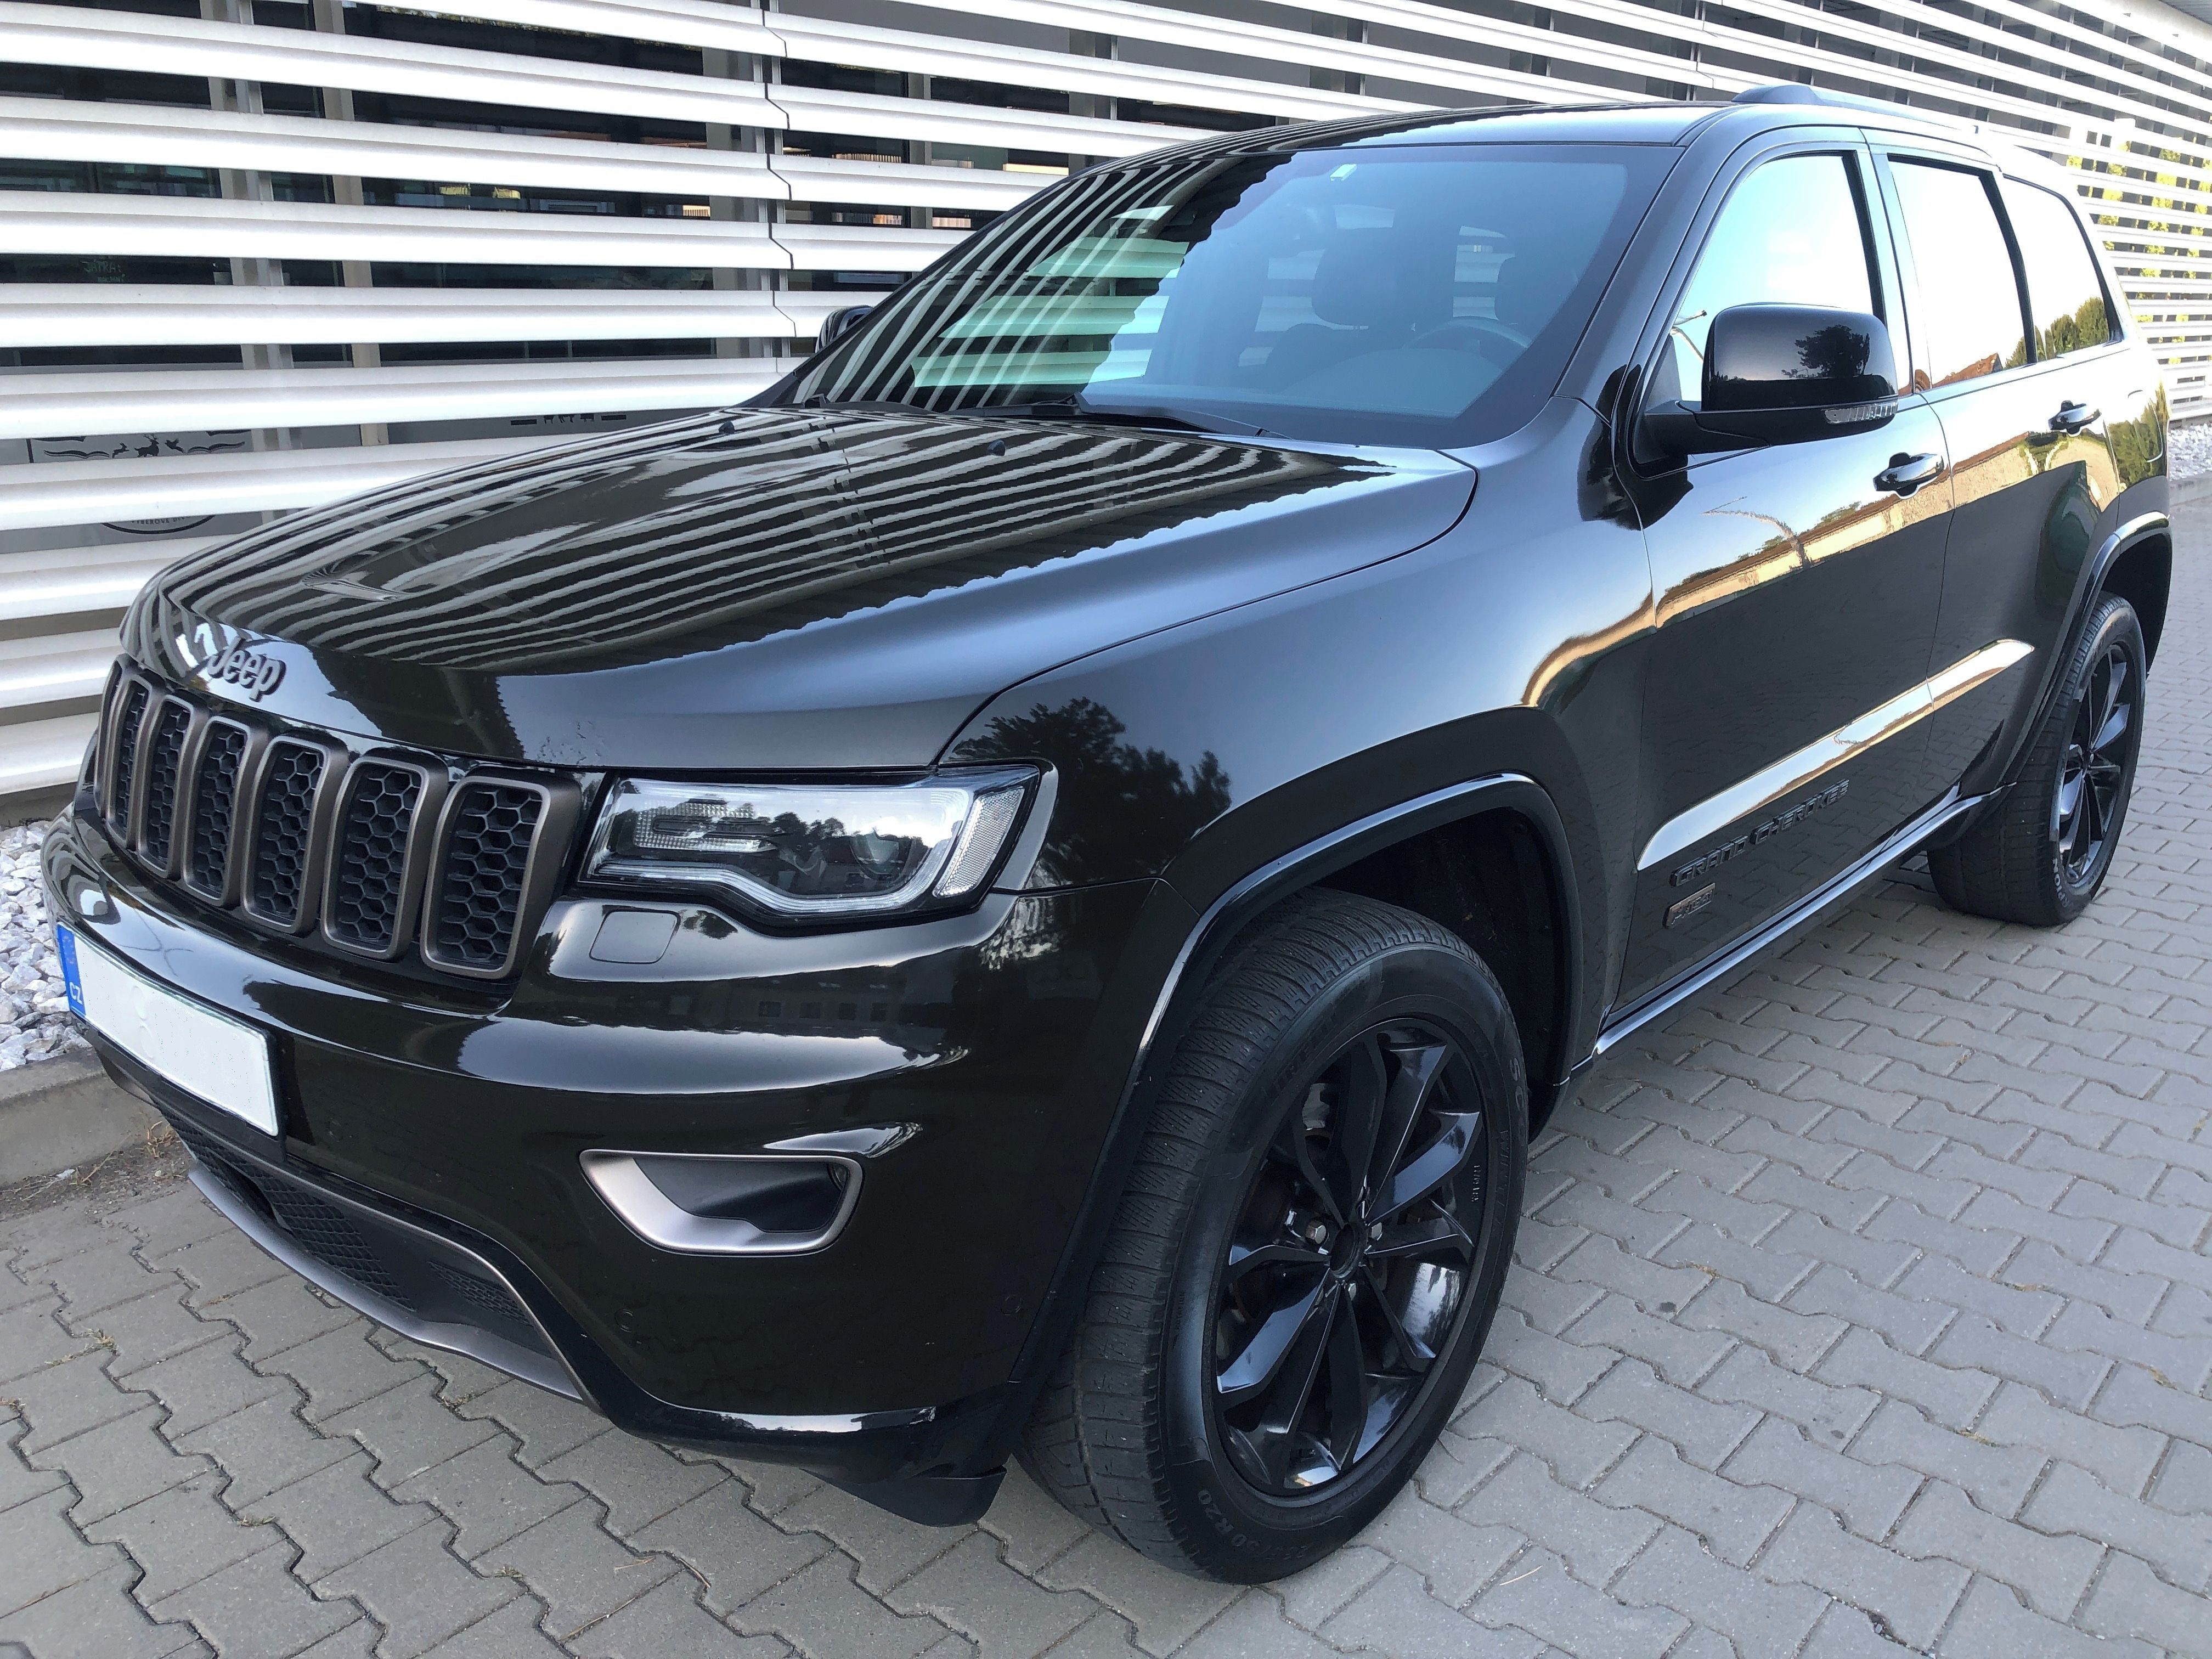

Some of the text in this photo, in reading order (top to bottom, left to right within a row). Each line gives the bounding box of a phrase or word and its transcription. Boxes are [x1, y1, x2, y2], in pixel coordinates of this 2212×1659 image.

[207, 636, 286, 702] Jeep
[1671, 778, 1849, 887] GRAND CHEROKEE
[69, 982, 83, 1005] CZ
